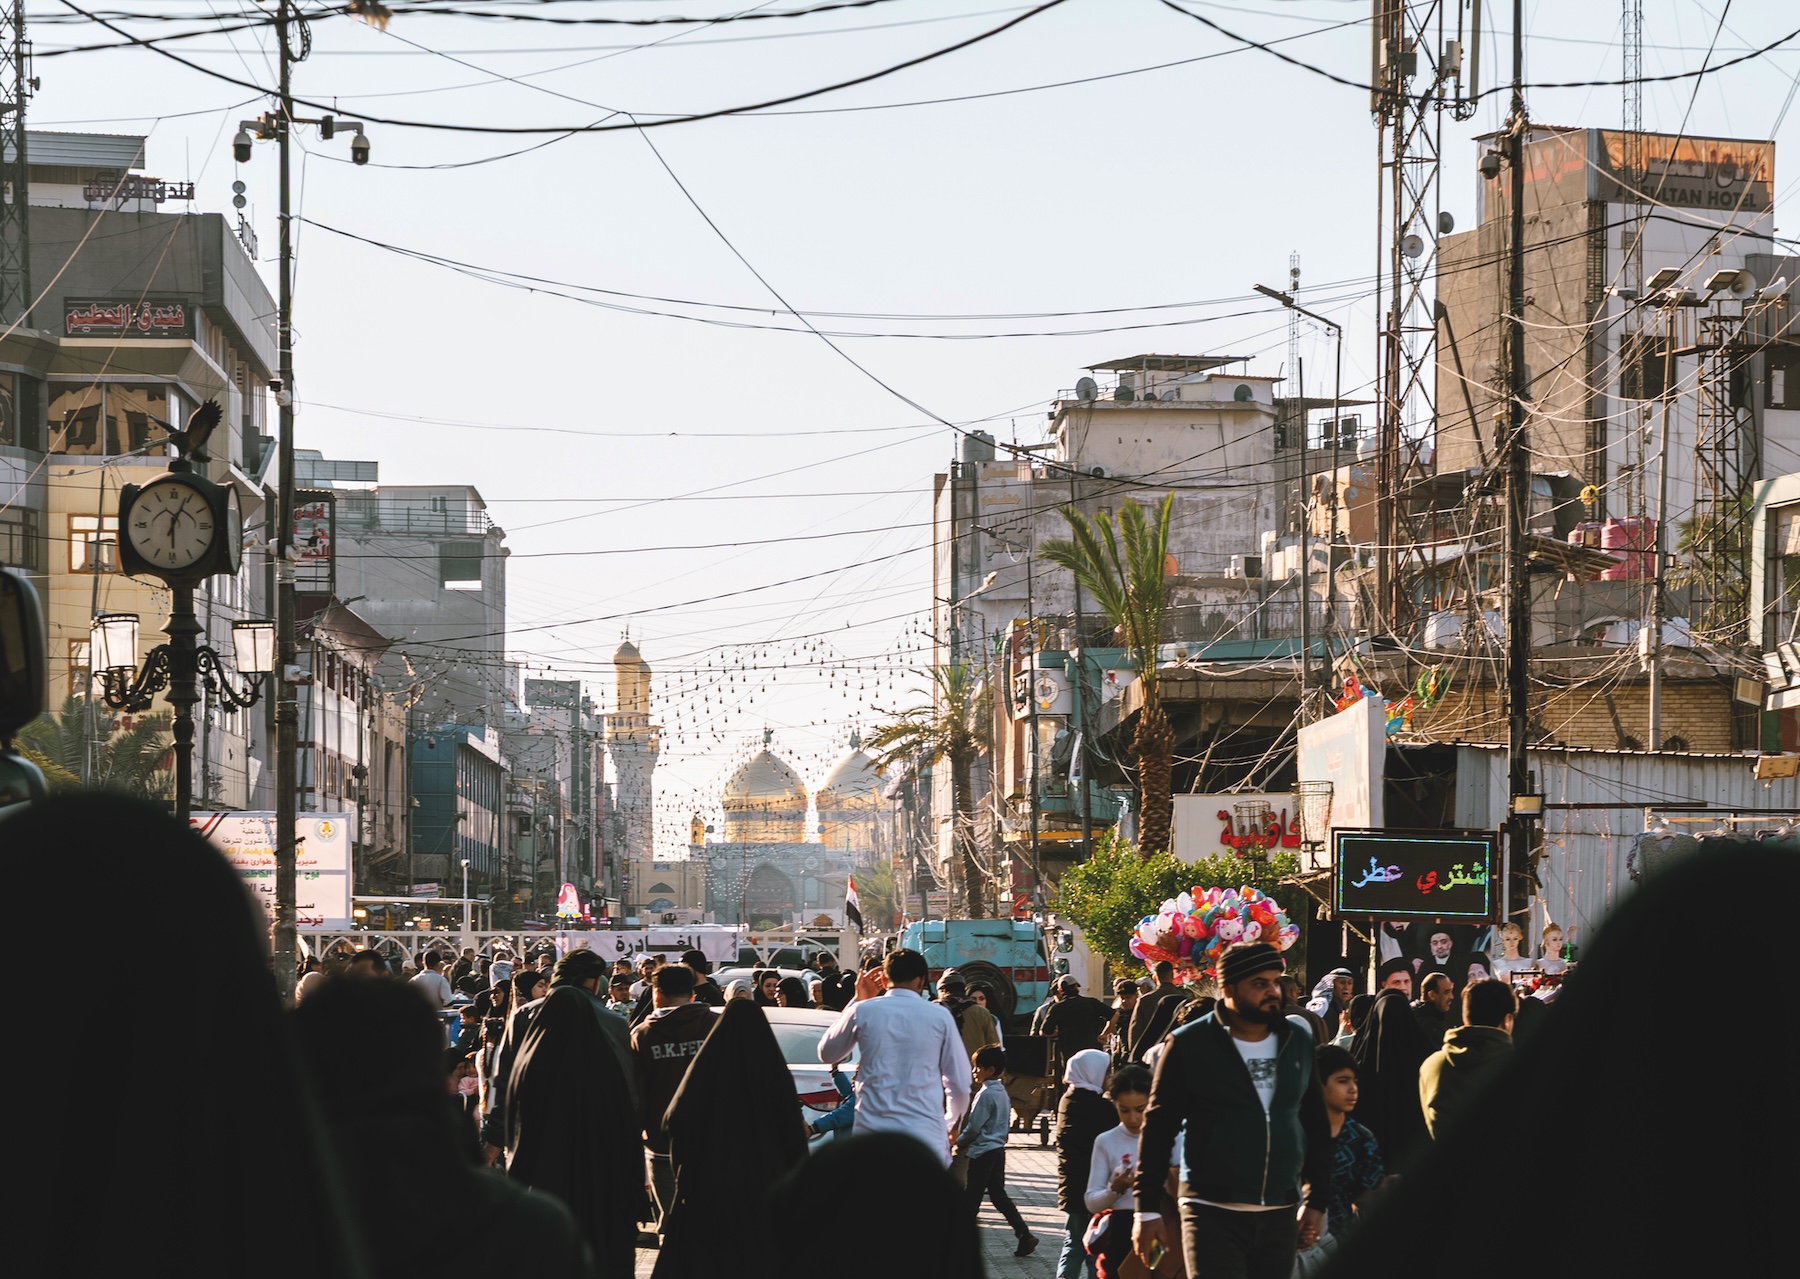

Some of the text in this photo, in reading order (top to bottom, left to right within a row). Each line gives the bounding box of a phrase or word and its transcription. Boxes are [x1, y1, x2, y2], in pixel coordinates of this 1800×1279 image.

[66, 302, 184, 333] فندق الحطيم
[1351, 855, 1404, 888] عطر
